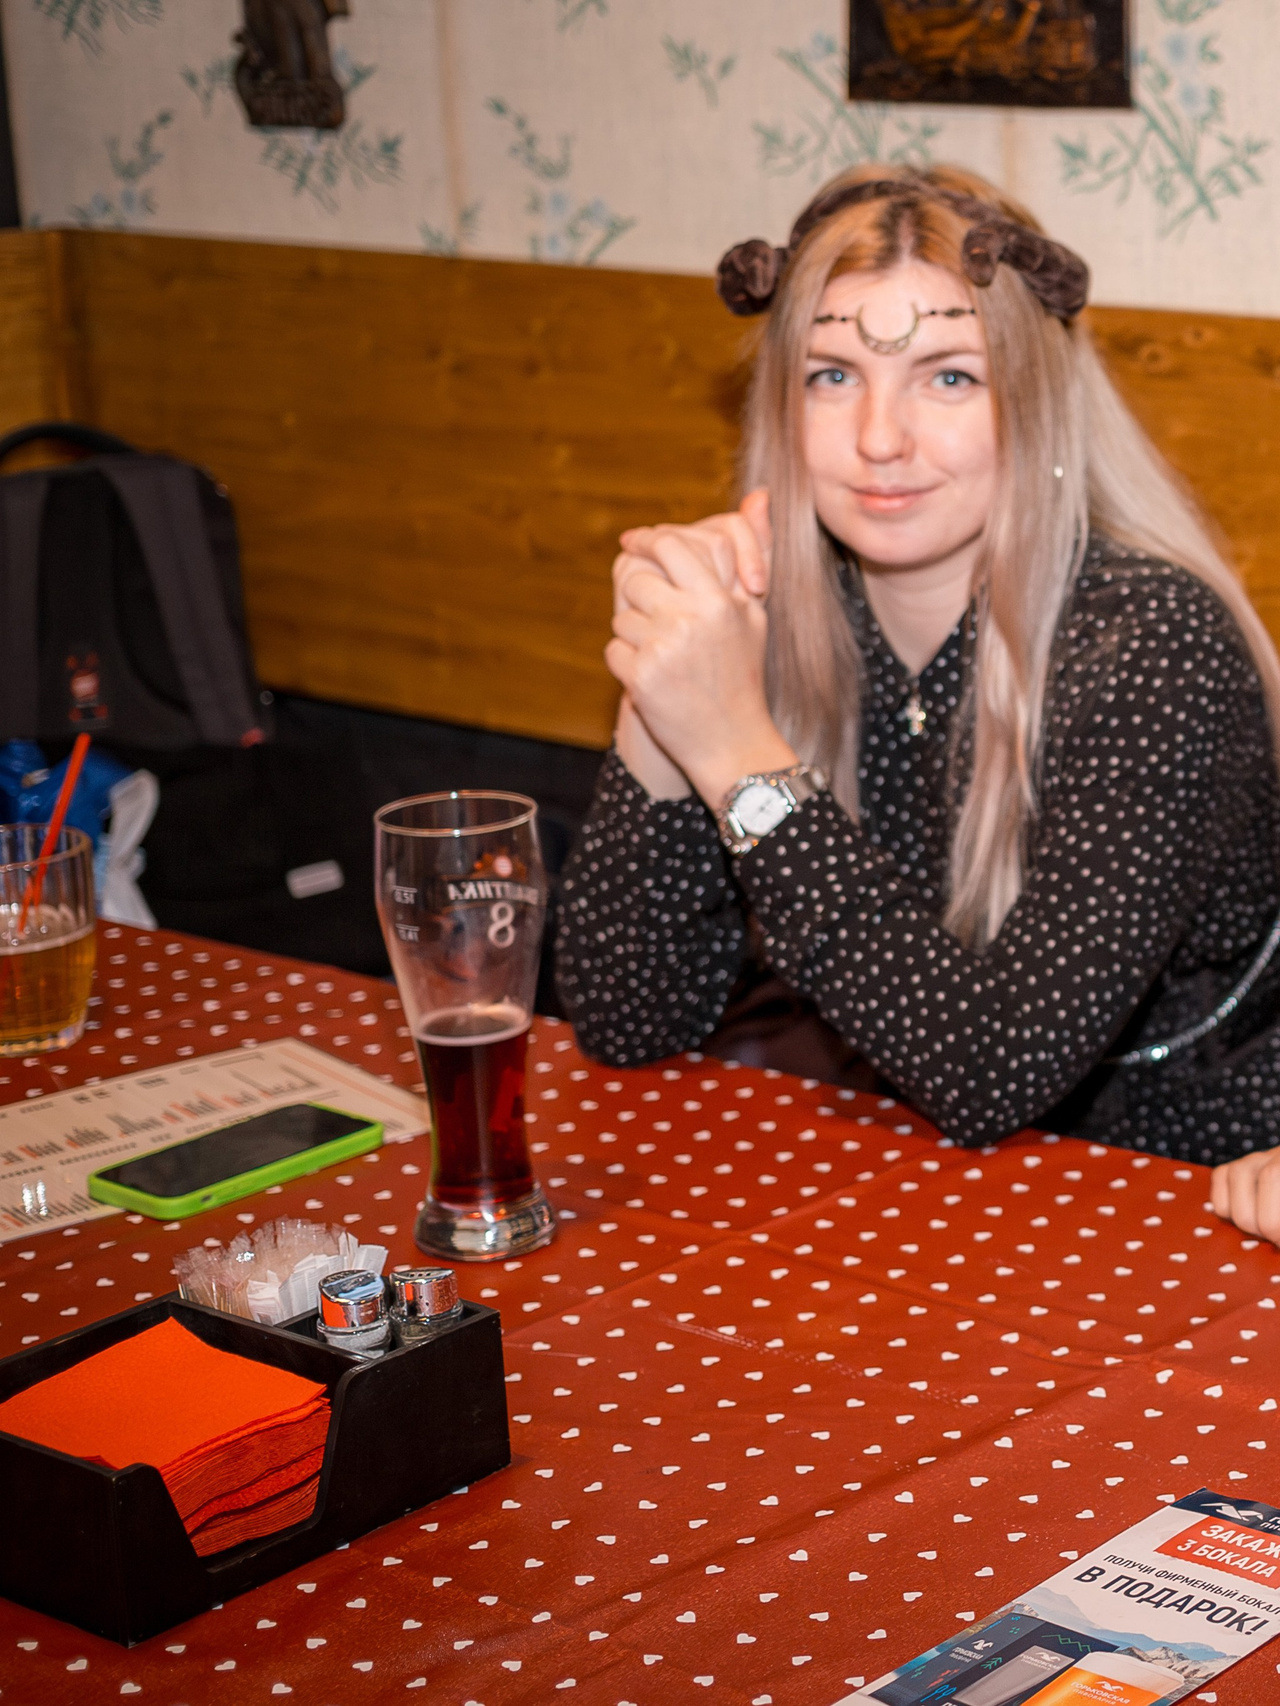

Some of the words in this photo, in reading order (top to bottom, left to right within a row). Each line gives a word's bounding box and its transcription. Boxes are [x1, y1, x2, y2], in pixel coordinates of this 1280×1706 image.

[1176, 1539, 1198, 1551] 3
[1103, 1554, 1157, 1575] ПОЛУЧИ
[1154, 1569, 1239, 1599] ФИРМЕННЫЙ
[1073, 1566, 1106, 1583] В
[1101, 1574, 1269, 1636] ПОДАРОК!
